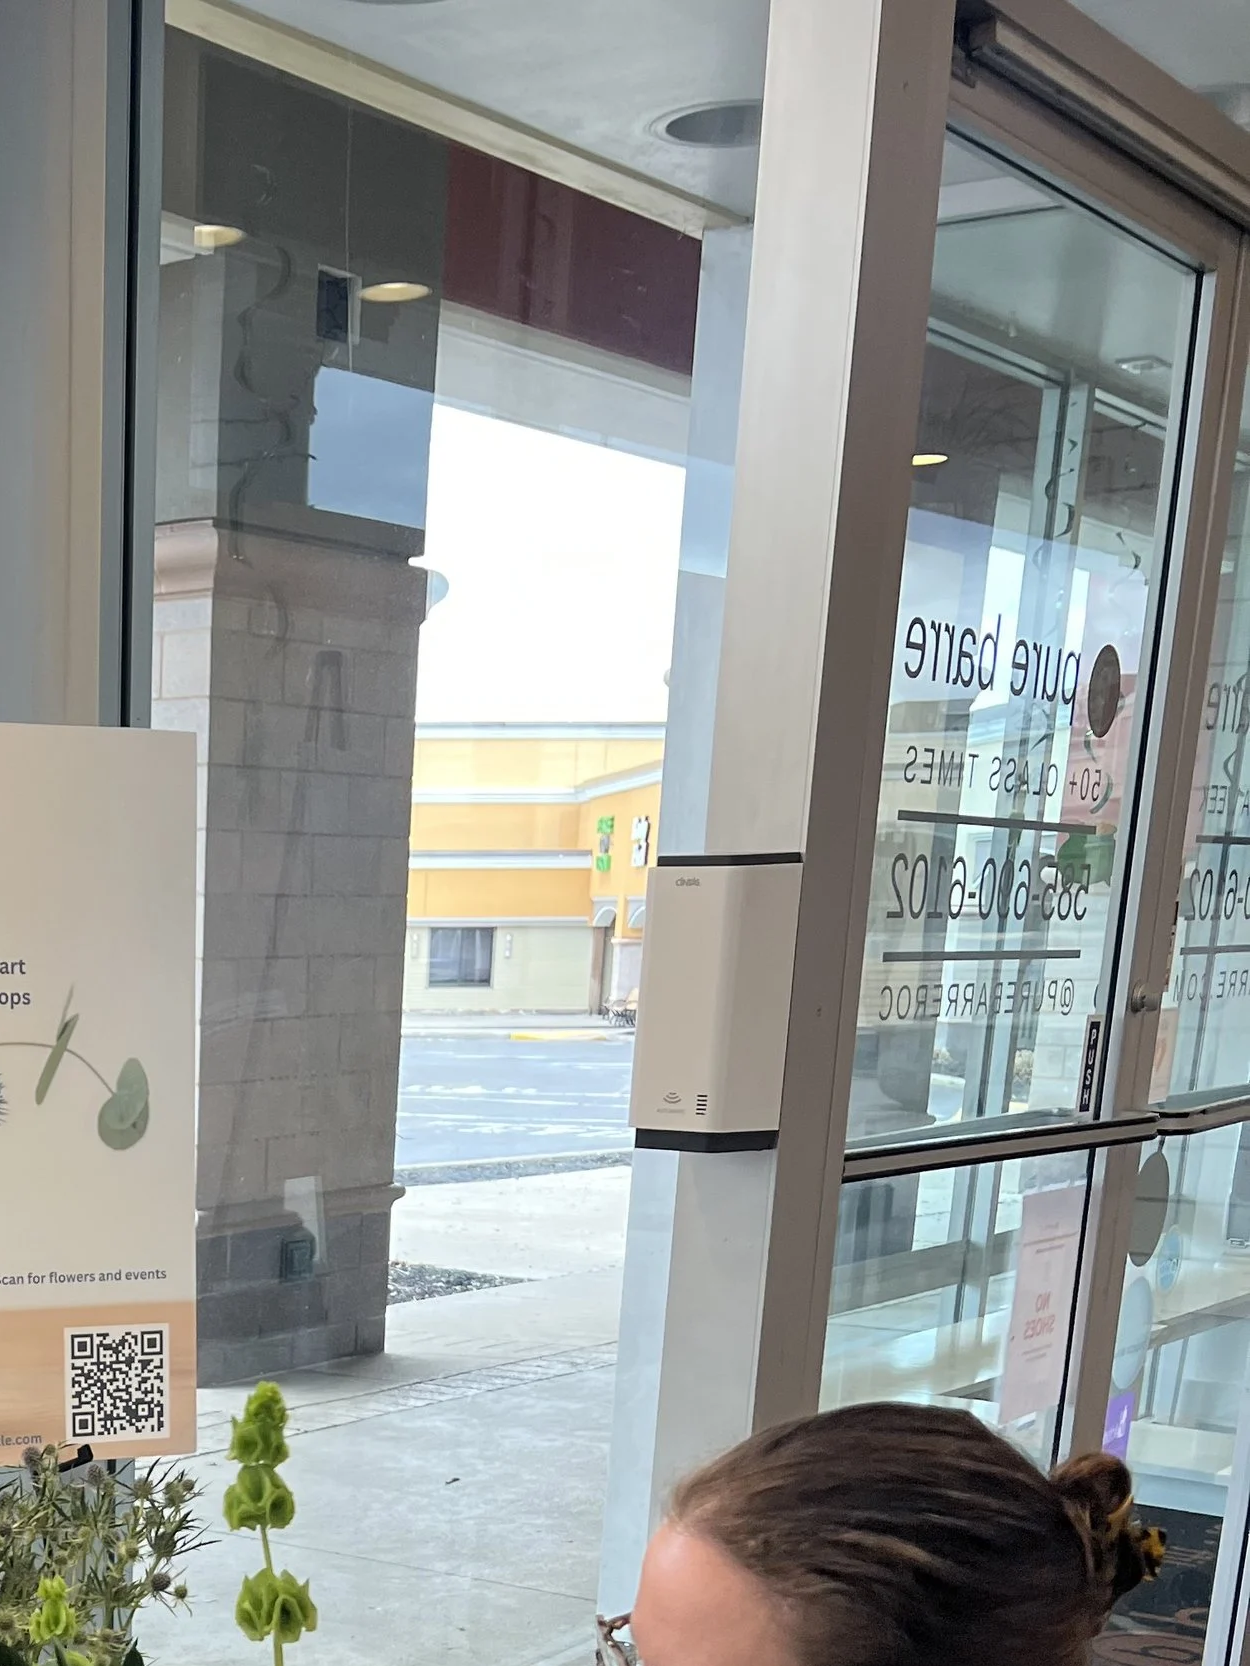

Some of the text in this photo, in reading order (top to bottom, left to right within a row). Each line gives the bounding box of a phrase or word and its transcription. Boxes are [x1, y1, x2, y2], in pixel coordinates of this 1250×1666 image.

[1081, 1027, 1098, 1106] PUSH
[27, 1272, 47, 1286] for
[49, 1271, 97, 1285] flowers
[98, 1269, 123, 1283] and
[125, 1268, 168, 1281] events
